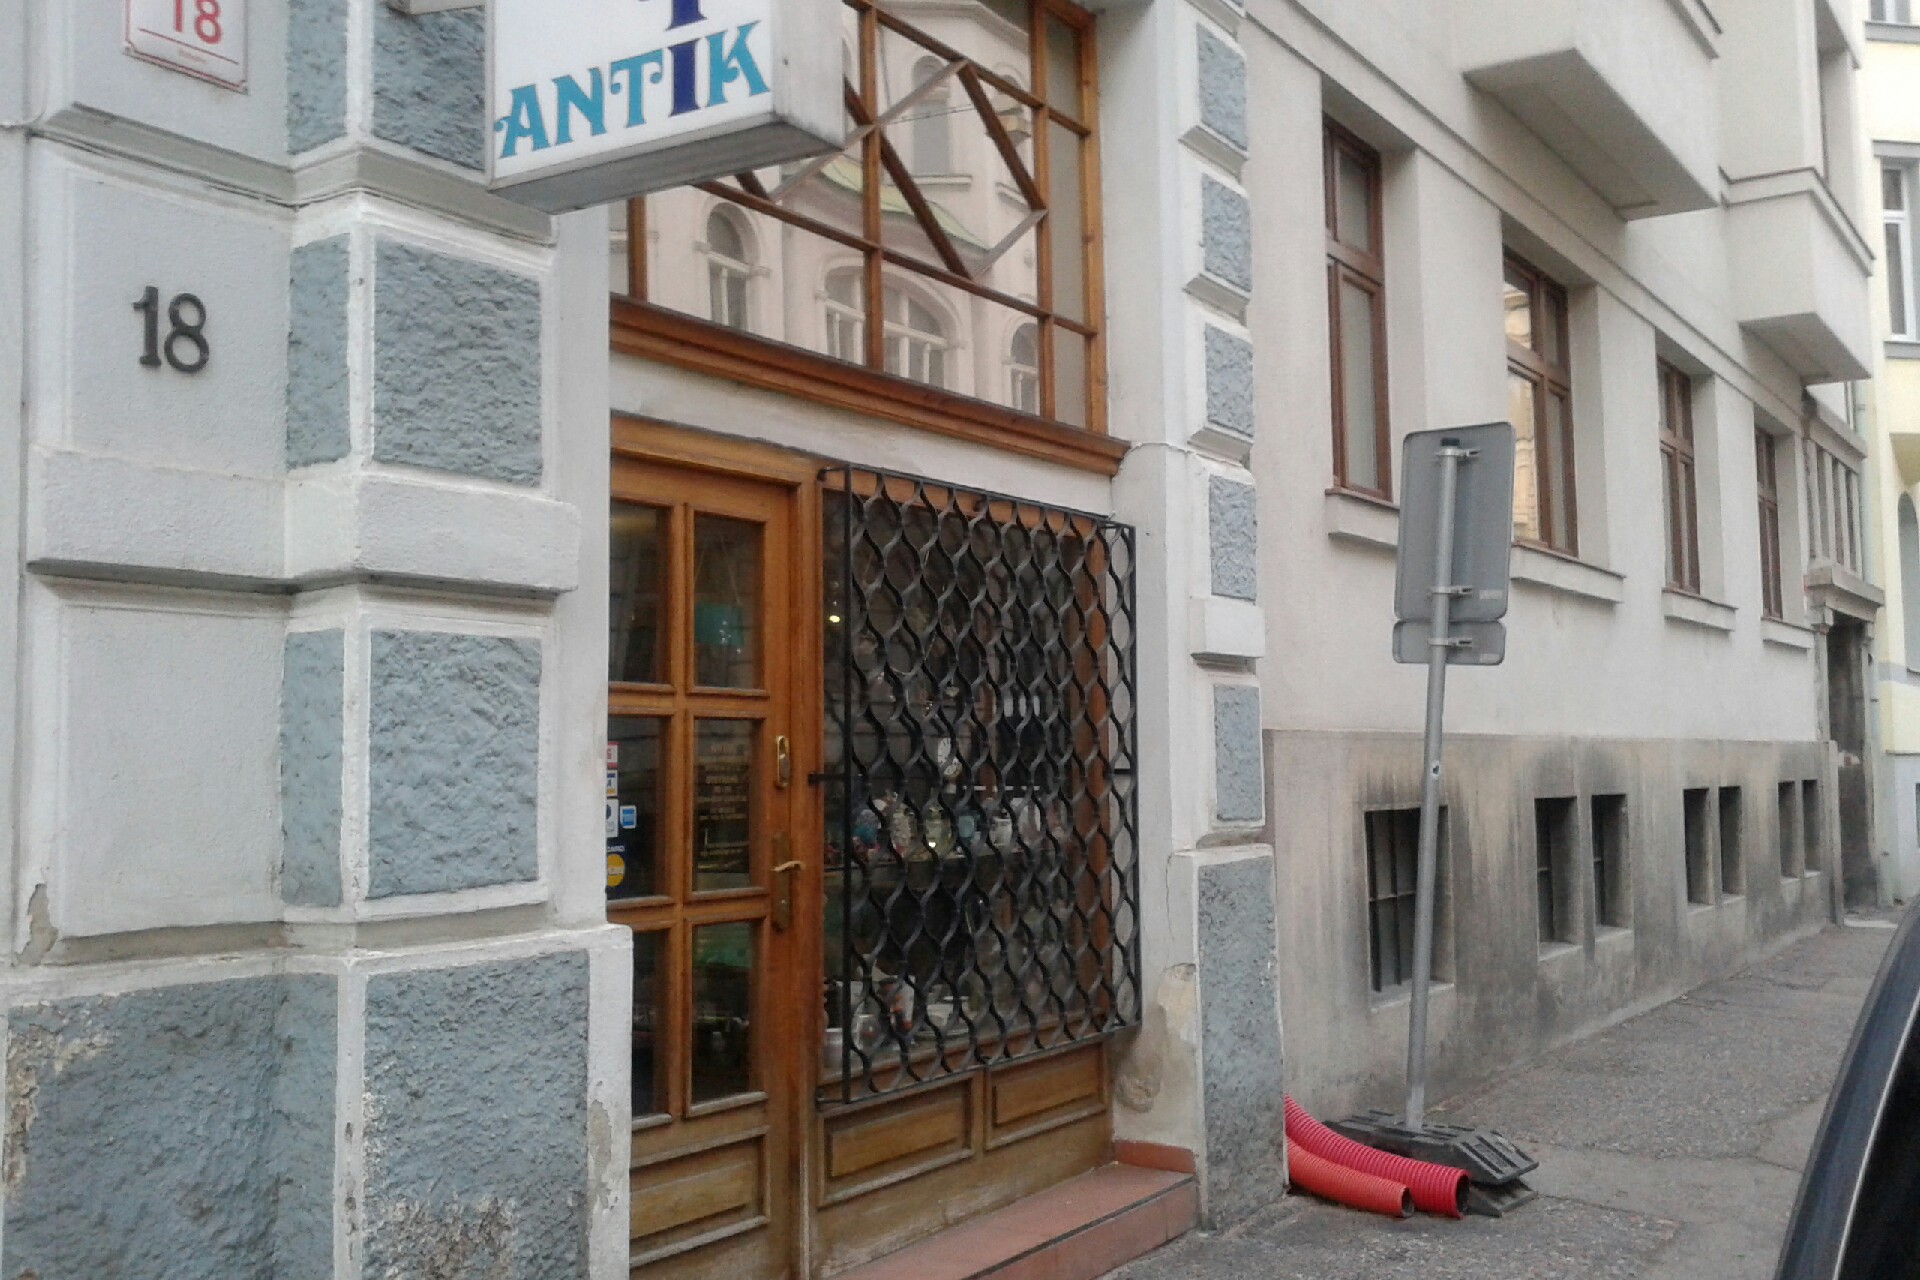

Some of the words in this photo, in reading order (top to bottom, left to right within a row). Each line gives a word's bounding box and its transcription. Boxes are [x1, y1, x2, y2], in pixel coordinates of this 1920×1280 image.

[174, 0, 222, 44] 18
[494, 20, 770, 159] ANTIK
[132, 286, 210, 373] 18
